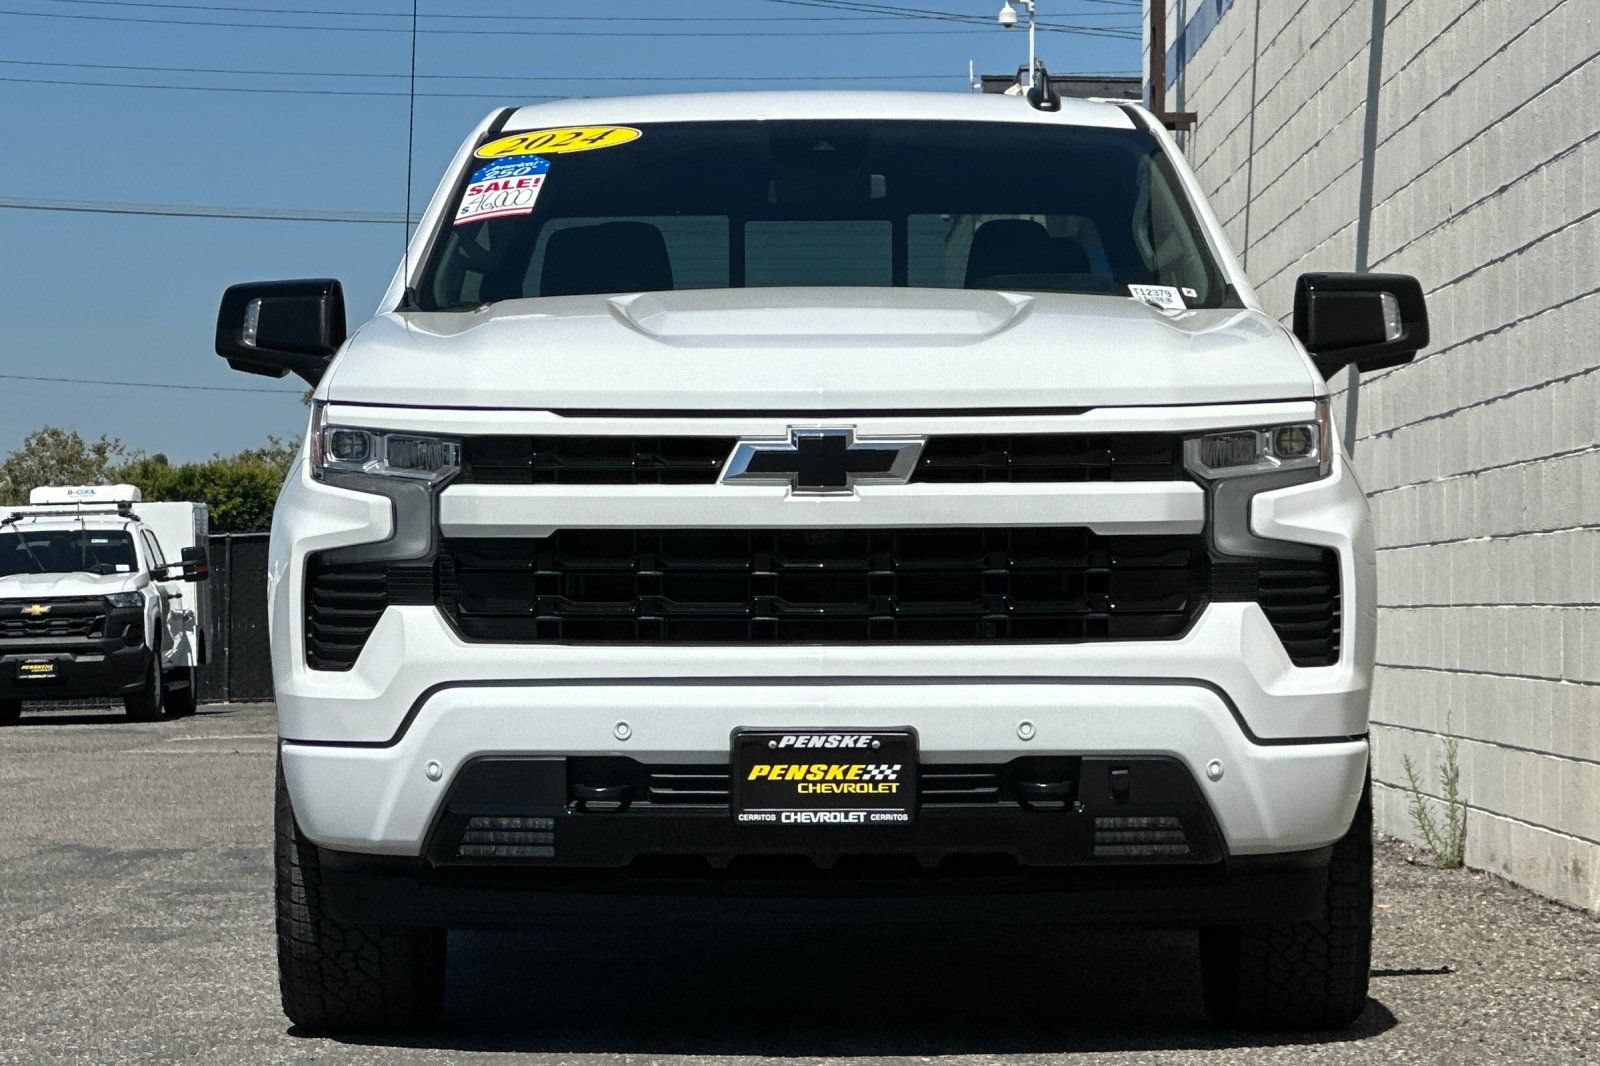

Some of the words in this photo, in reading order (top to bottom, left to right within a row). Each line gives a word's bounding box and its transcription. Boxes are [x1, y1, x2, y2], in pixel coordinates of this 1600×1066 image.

[496, 129, 618, 154] 2024
[482, 167, 531, 180] 250
[468, 178, 540, 196] SALE!
[778, 735, 872, 748] PENSKE
[748, 764, 866, 780] PENSKE
[797, 783, 899, 793] CHEVROLET
[738, 813, 776, 821] CERRITOS
[781, 811, 867, 823] CHEVROLET
[870, 813, 908, 821] CERRITOS
